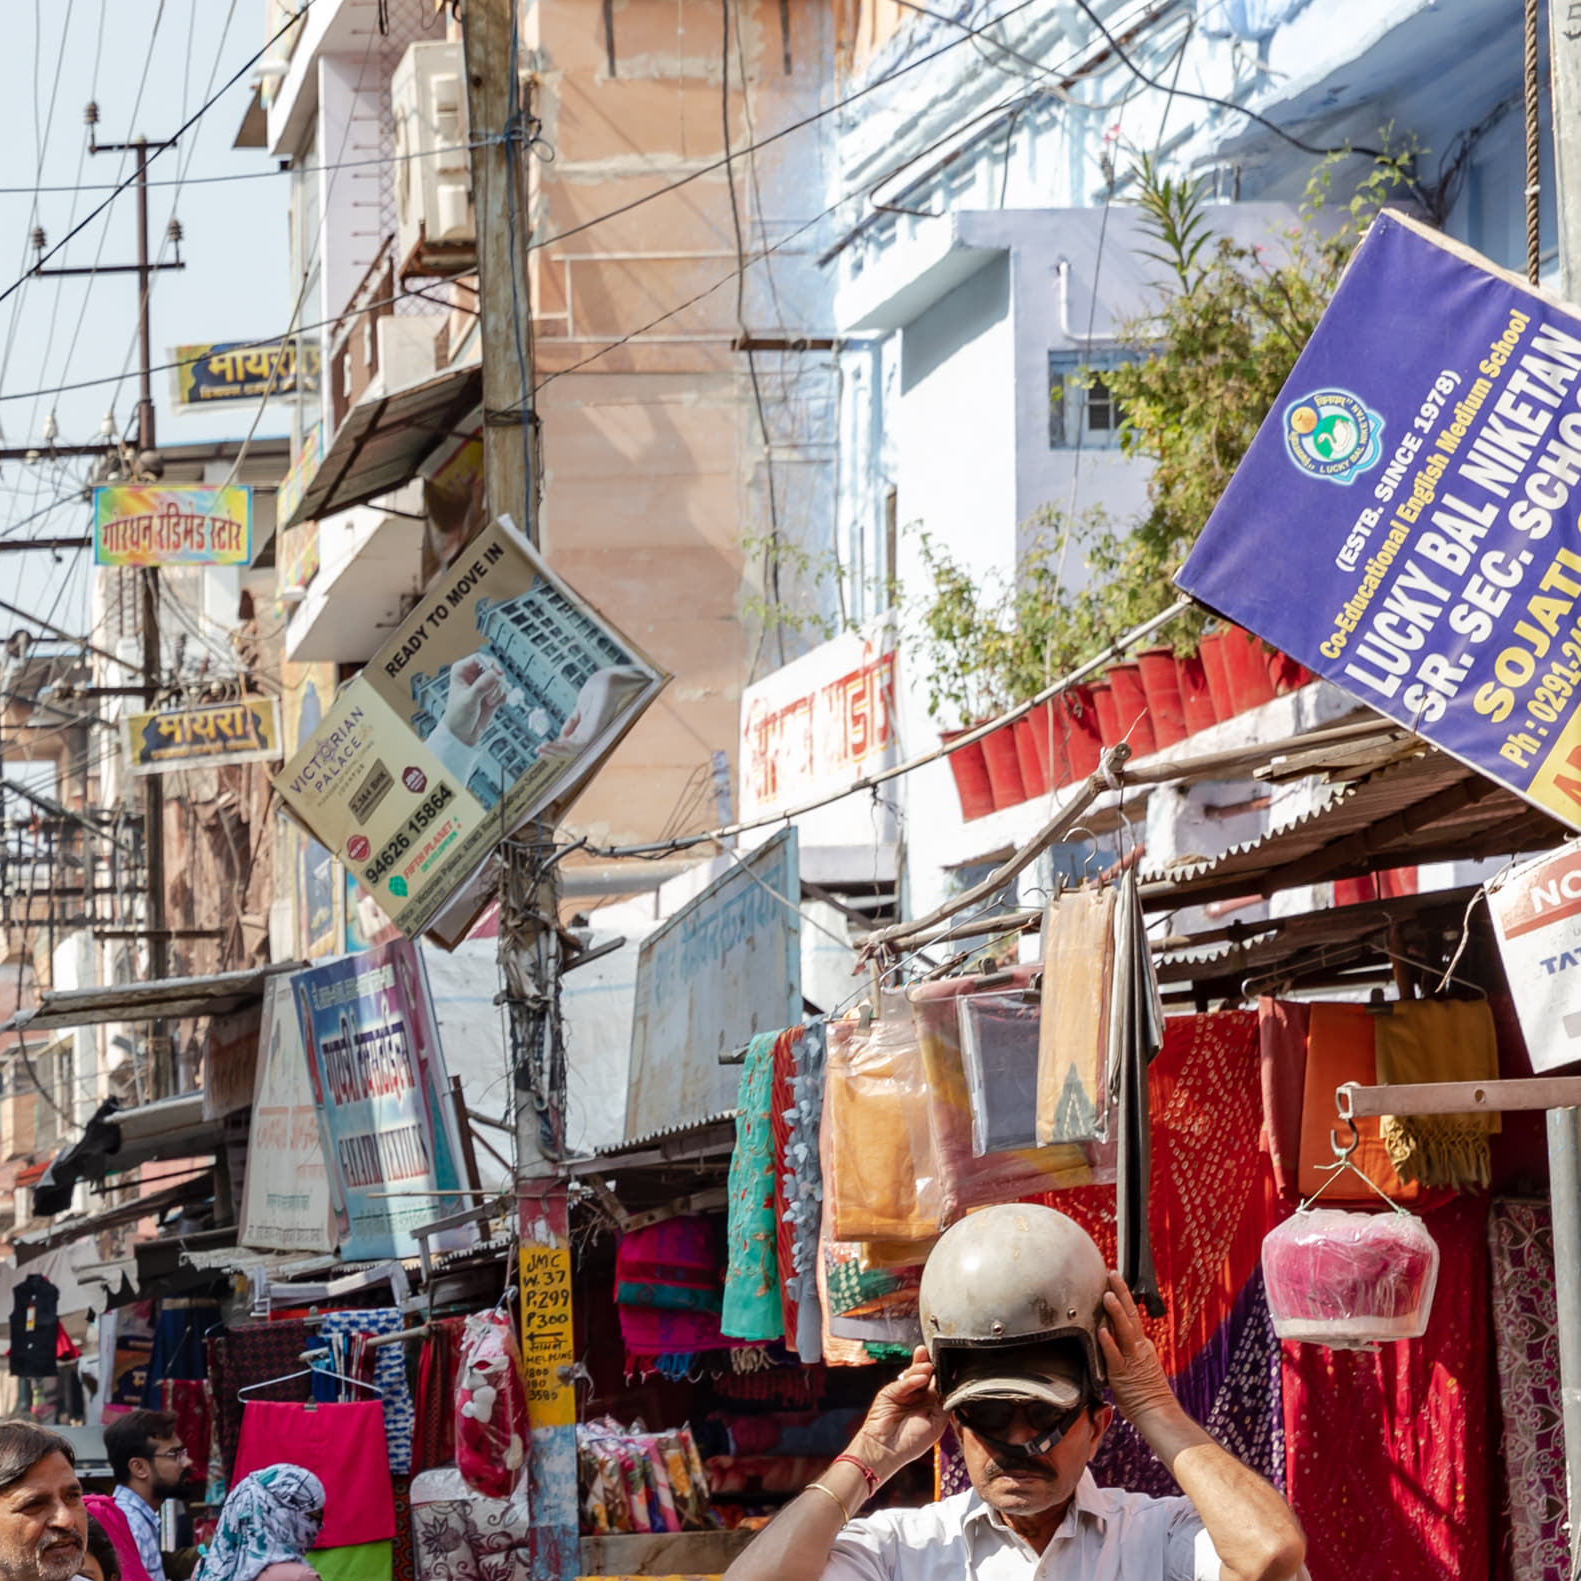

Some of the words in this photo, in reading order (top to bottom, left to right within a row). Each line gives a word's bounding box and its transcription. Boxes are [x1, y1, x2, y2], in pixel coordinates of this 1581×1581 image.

[1320, 521, 1410, 660] Co-Educational
[1396, 451, 1450, 525] English
[1436, 378, 1492, 452] Medium
[1479, 308, 1531, 377] School
[1335, 503, 1385, 572] (ESTB.
[1375, 432, 1423, 503] SINCE
[1414, 370, 1462, 434] 1978)
[1344, 561, 1452, 698] LUCKY
[1415, 493, 1500, 577] BAL
[1458, 323, 1581, 500] NIKETAN
[209, 510, 242, 552] स्टोर
[385, 625, 430, 679] READY
[426, 605, 449, 630] TO
[446, 561, 489, 616] MOVE
[485, 542, 506, 573] IN
[1402, 653, 1476, 723] SR.
[1449, 550, 1534, 644] SEC.
[289, 705, 366, 794] VICTORIAN
[313, 736, 363, 793] PALACE
[365, 833, 410, 885] 94626
[408, 784, 454, 834] 15864
[526, 1253, 561, 1273] JMC
